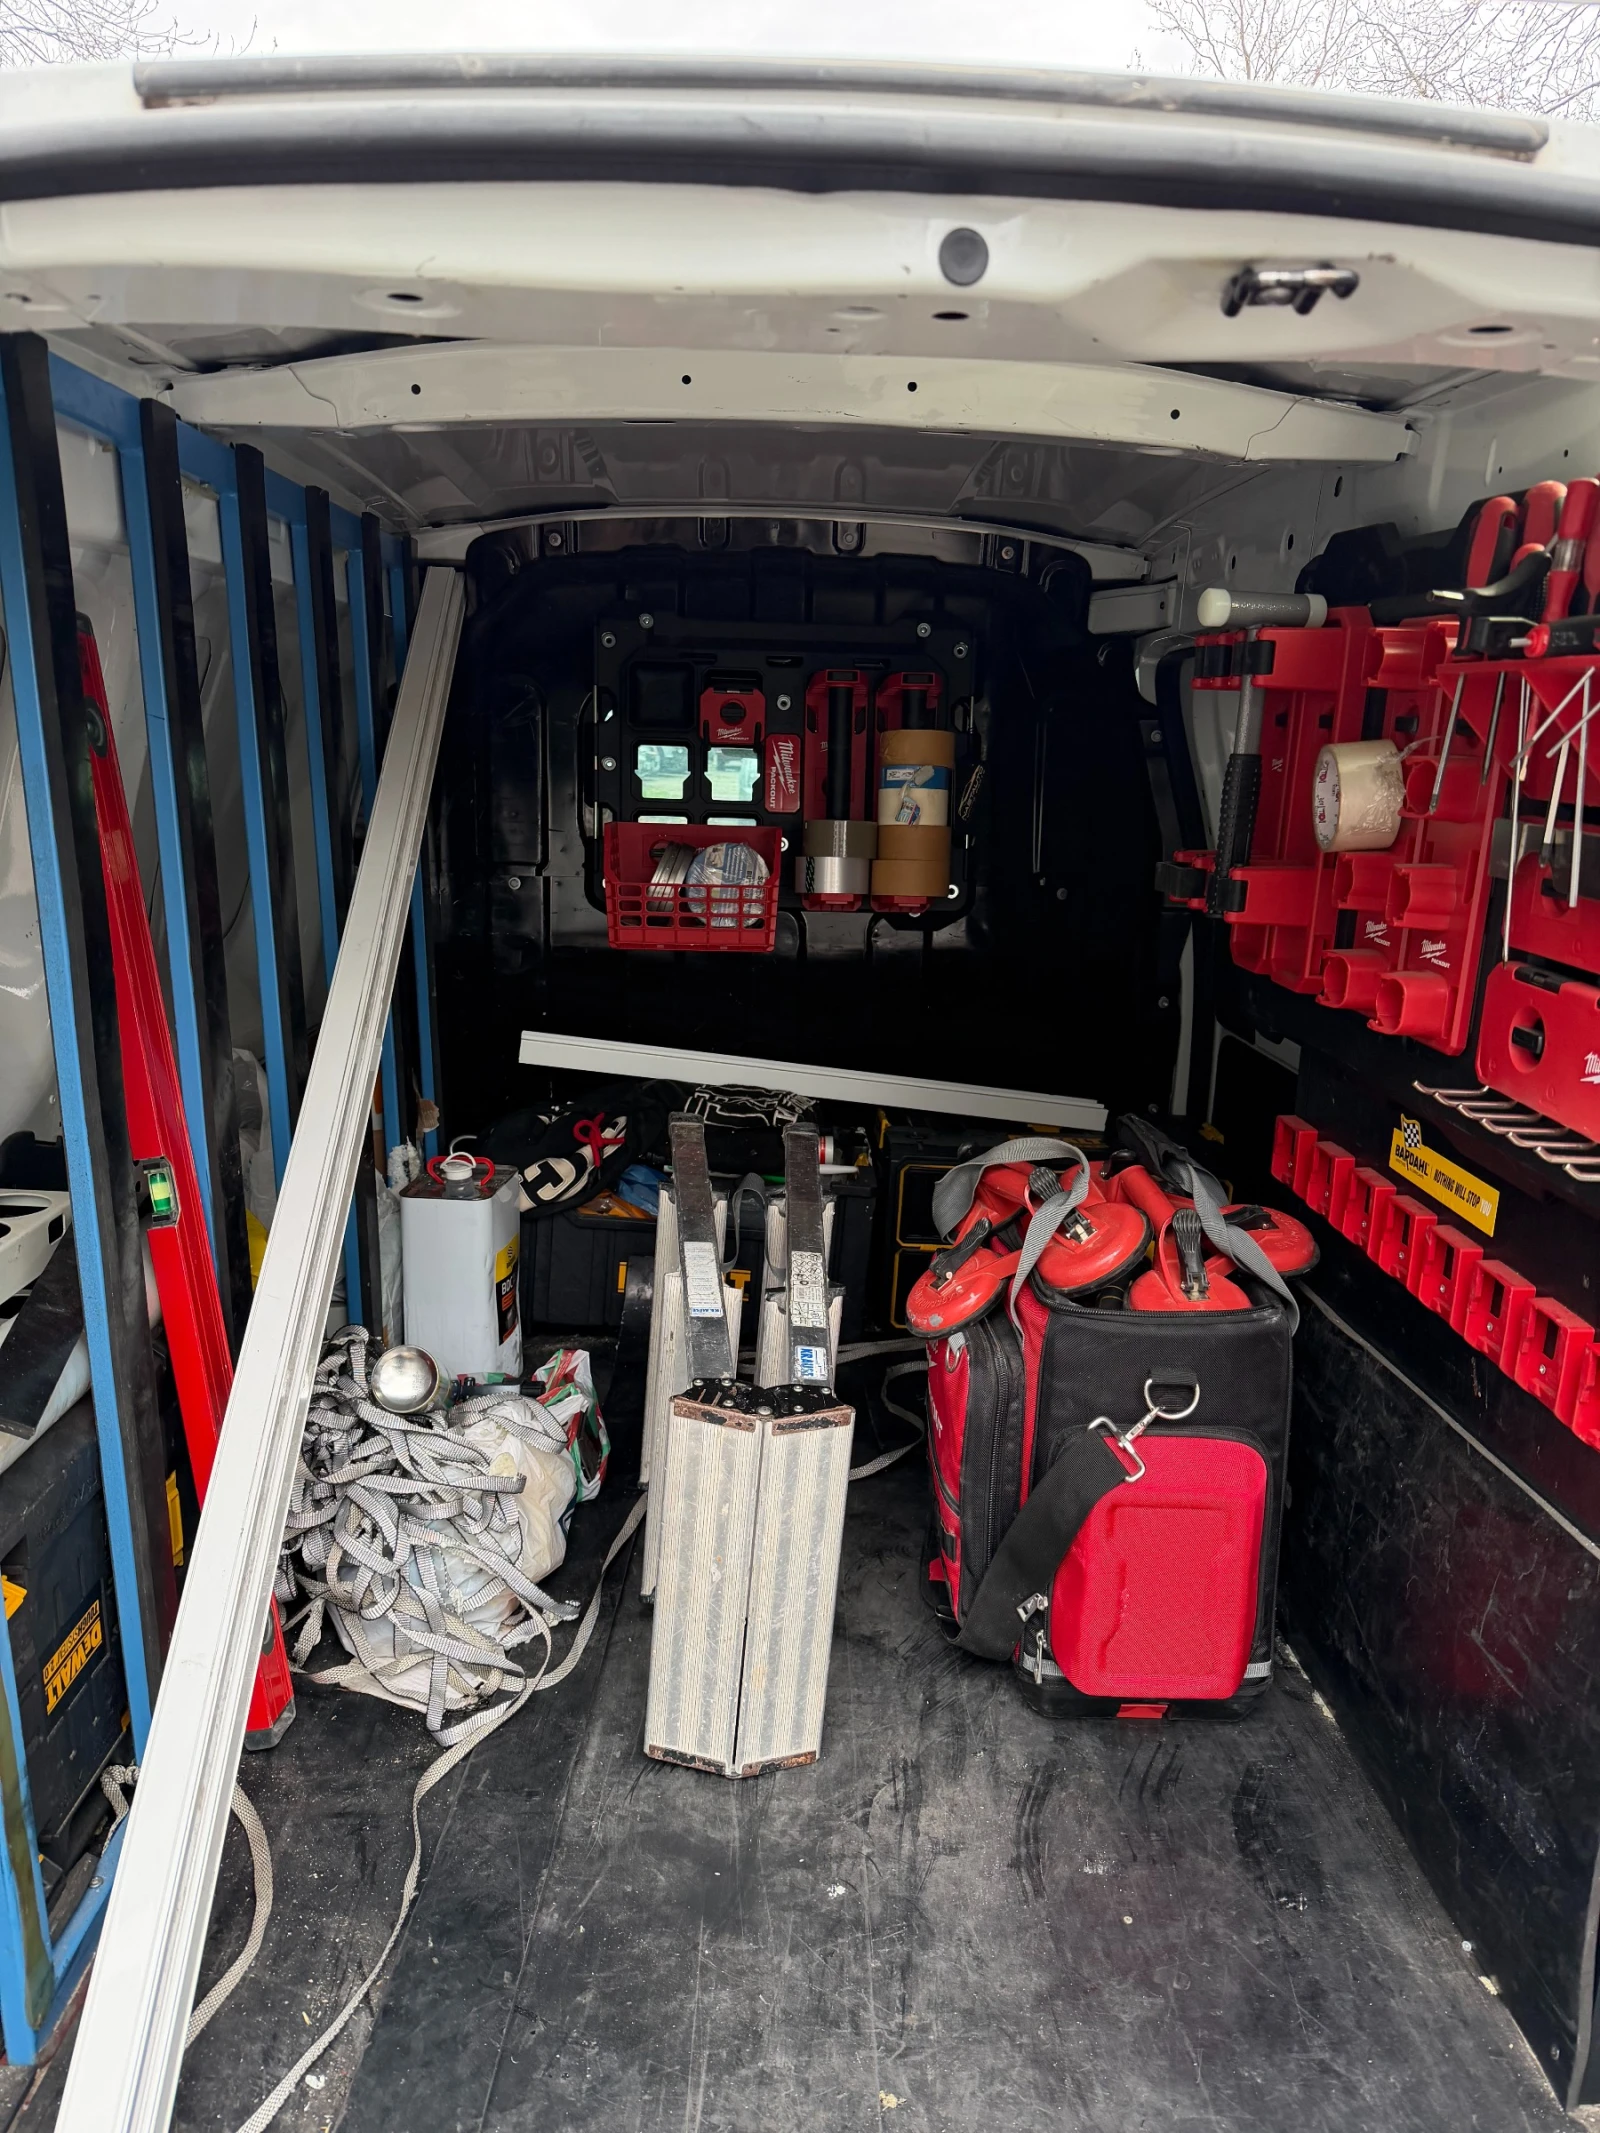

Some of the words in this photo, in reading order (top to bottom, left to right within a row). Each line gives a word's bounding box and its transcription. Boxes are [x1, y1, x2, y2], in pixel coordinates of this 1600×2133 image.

[778, 739, 797, 794] Milwaukee
[769, 766, 778, 808] PACKOUT
[1365, 920, 1388, 934] Milwaukee
[1373, 937, 1391, 947] PACKOUT
[1421, 938, 1446, 953] Milwaukee
[1430, 957, 1451, 969] PACKOUT
[1395, 1144, 1428, 1176] BARDAHL
[1433, 1168, 1455, 1193] NOTHING
[1453, 1182, 1468, 1201] WILL
[1465, 1189, 1481, 1209] STOP
[1480, 1198, 1492, 1217] YOU
[800, 1348, 815, 1377] KRAUSE
[46, 1618, 103, 1716] DEWALT
